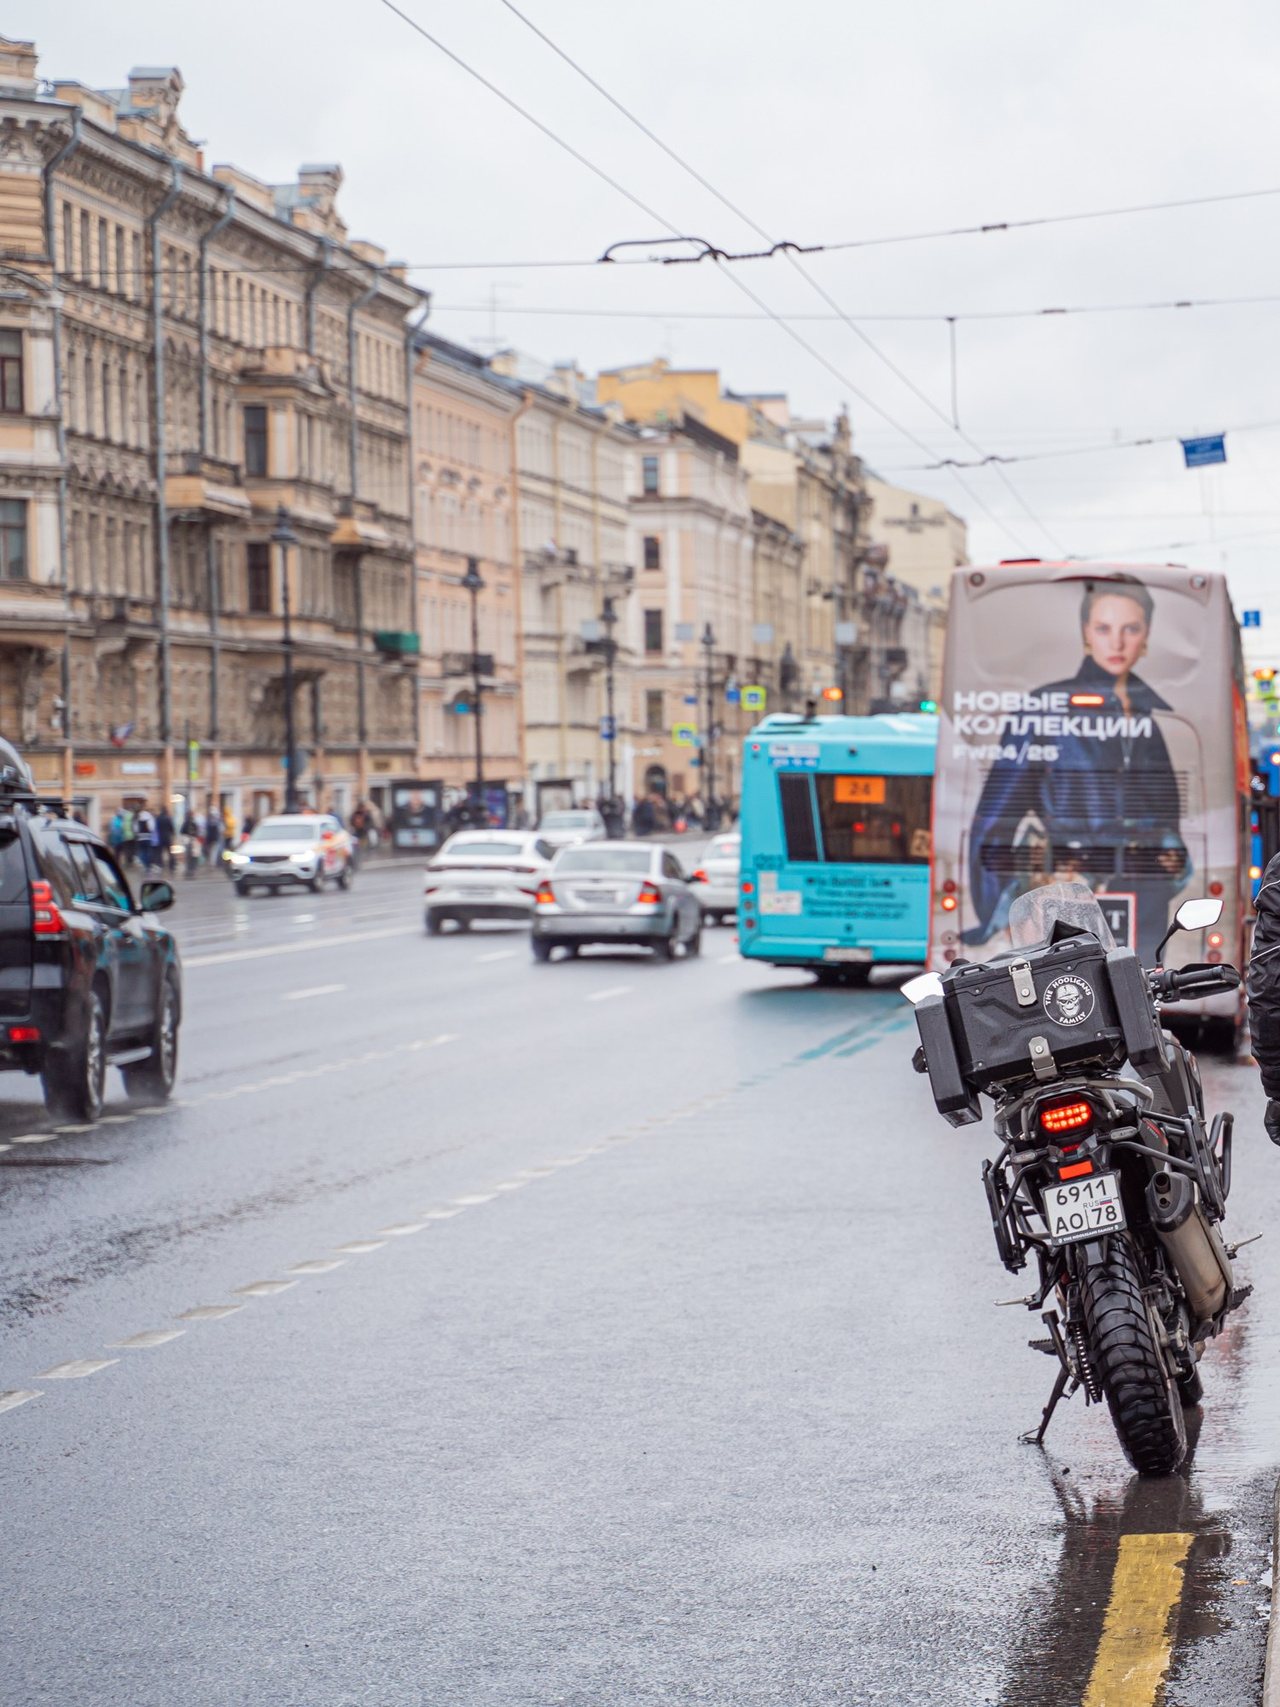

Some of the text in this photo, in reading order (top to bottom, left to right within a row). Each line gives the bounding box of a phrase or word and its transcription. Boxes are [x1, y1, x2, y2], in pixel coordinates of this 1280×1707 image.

[953, 691, 1070, 713] НОВЫЕ
[953, 714, 1153, 741] КОЛЛЕКЦИИ
[952, 741, 1061, 765] FW24/25
[1045, 977, 1092, 1006] THE HOOLIGANS
[1059, 1011, 1086, 1024] FAMILY
[1056, 1179, 1107, 1205] 6911
[1083, 1200, 1100, 1209] RUS
[1091, 1205, 1117, 1225] 78
